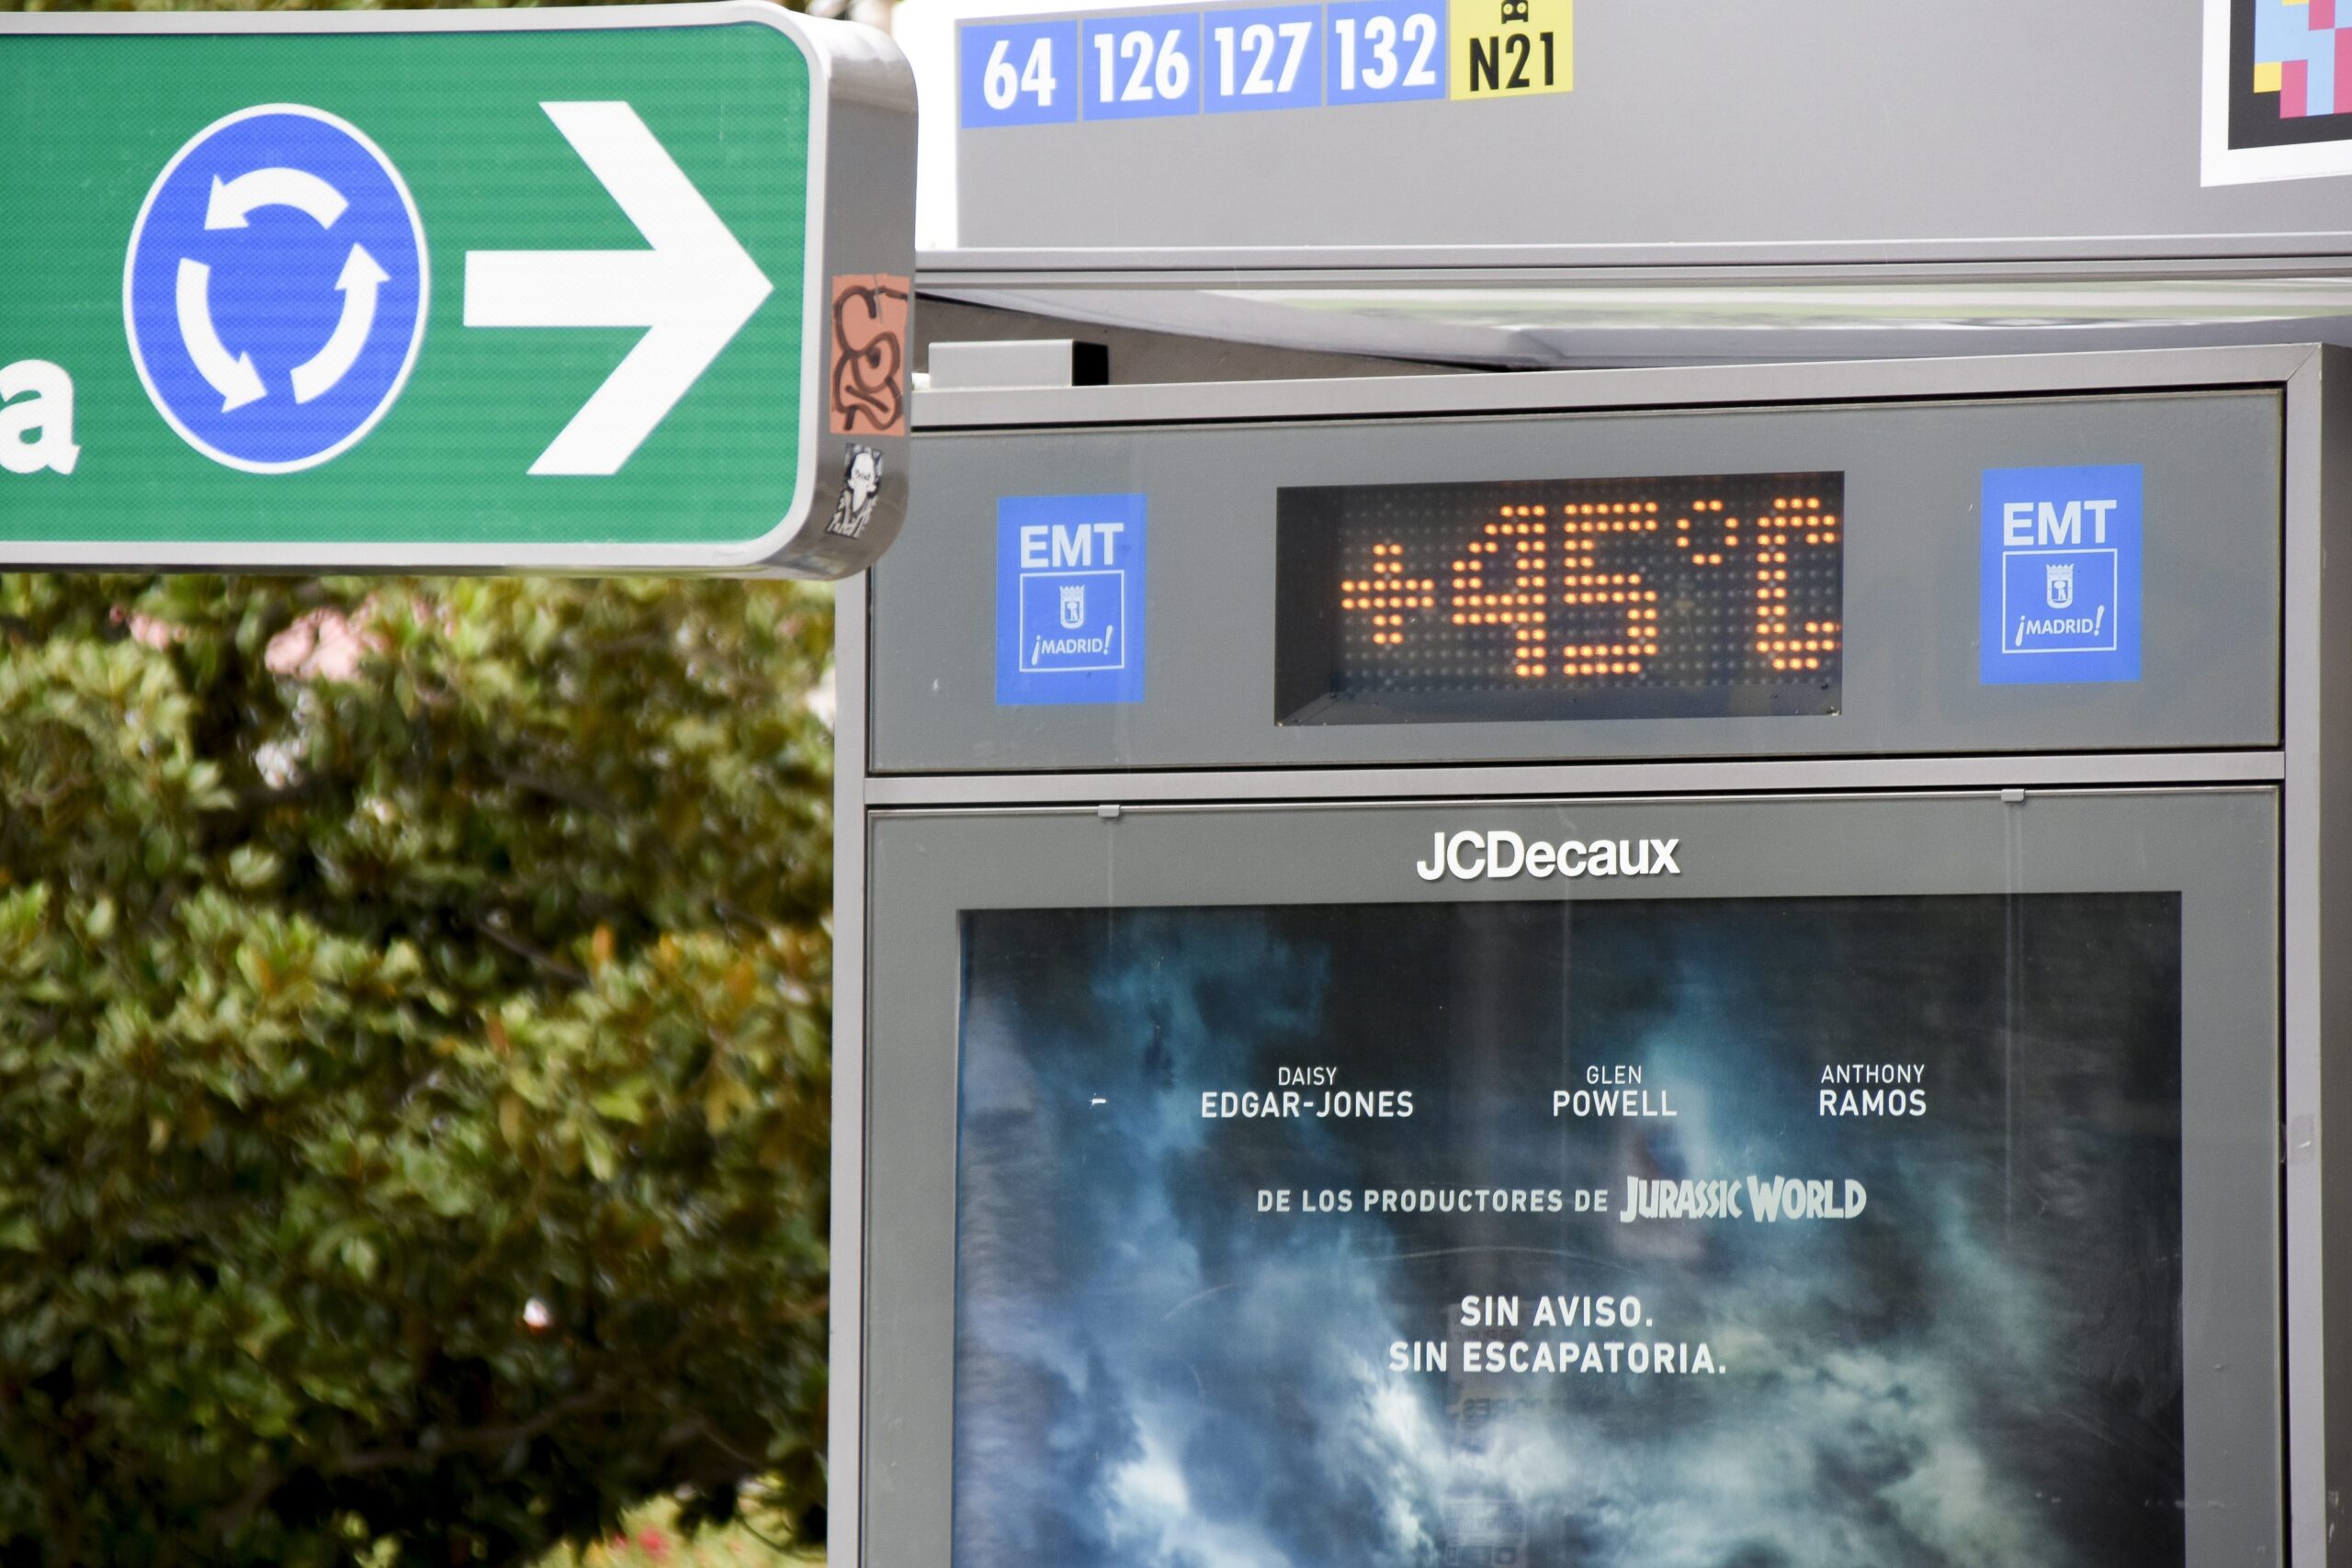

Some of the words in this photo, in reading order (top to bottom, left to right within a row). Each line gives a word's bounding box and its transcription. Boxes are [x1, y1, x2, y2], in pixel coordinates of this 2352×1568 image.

[982, 37, 1056, 110] 64
[1094, 29, 1192, 103] 126
[1214, 21, 1313, 96] 127
[1335, 13, 1438, 90] 132
[1470, 31, 1555, 92] N21
[2003, 499, 2118, 547] EMT
[1020, 522, 1125, 569] EMT
[1416, 830, 1680, 880] JCDecaux
[1277, 1066, 1338, 1086] DAISY
[1586, 1066, 1643, 1085] GLEN
[1820, 1064, 1927, 1084] ANTHONY
[1201, 1090, 1414, 1119] EDGAR-JONES
[1552, 1089, 1678, 1117] POWELL
[1819, 1089, 1928, 1117] RAMOS
[1257, 1190, 1291, 1213] DE
[1302, 1190, 1353, 1213] LOS
[1363, 1190, 1564, 1213] PRODUCTORES
[1574, 1190, 1609, 1213] DE
[1620, 1175, 1743, 1224] JURASSIC
[1747, 1175, 1867, 1223] WORLD
[1460, 1295, 1520, 1327] SIN
[1532, 1295, 1654, 1327] AVISO.
[1388, 1341, 1448, 1372] SIN
[1463, 1341, 1727, 1374] ESCAPATORIA.
